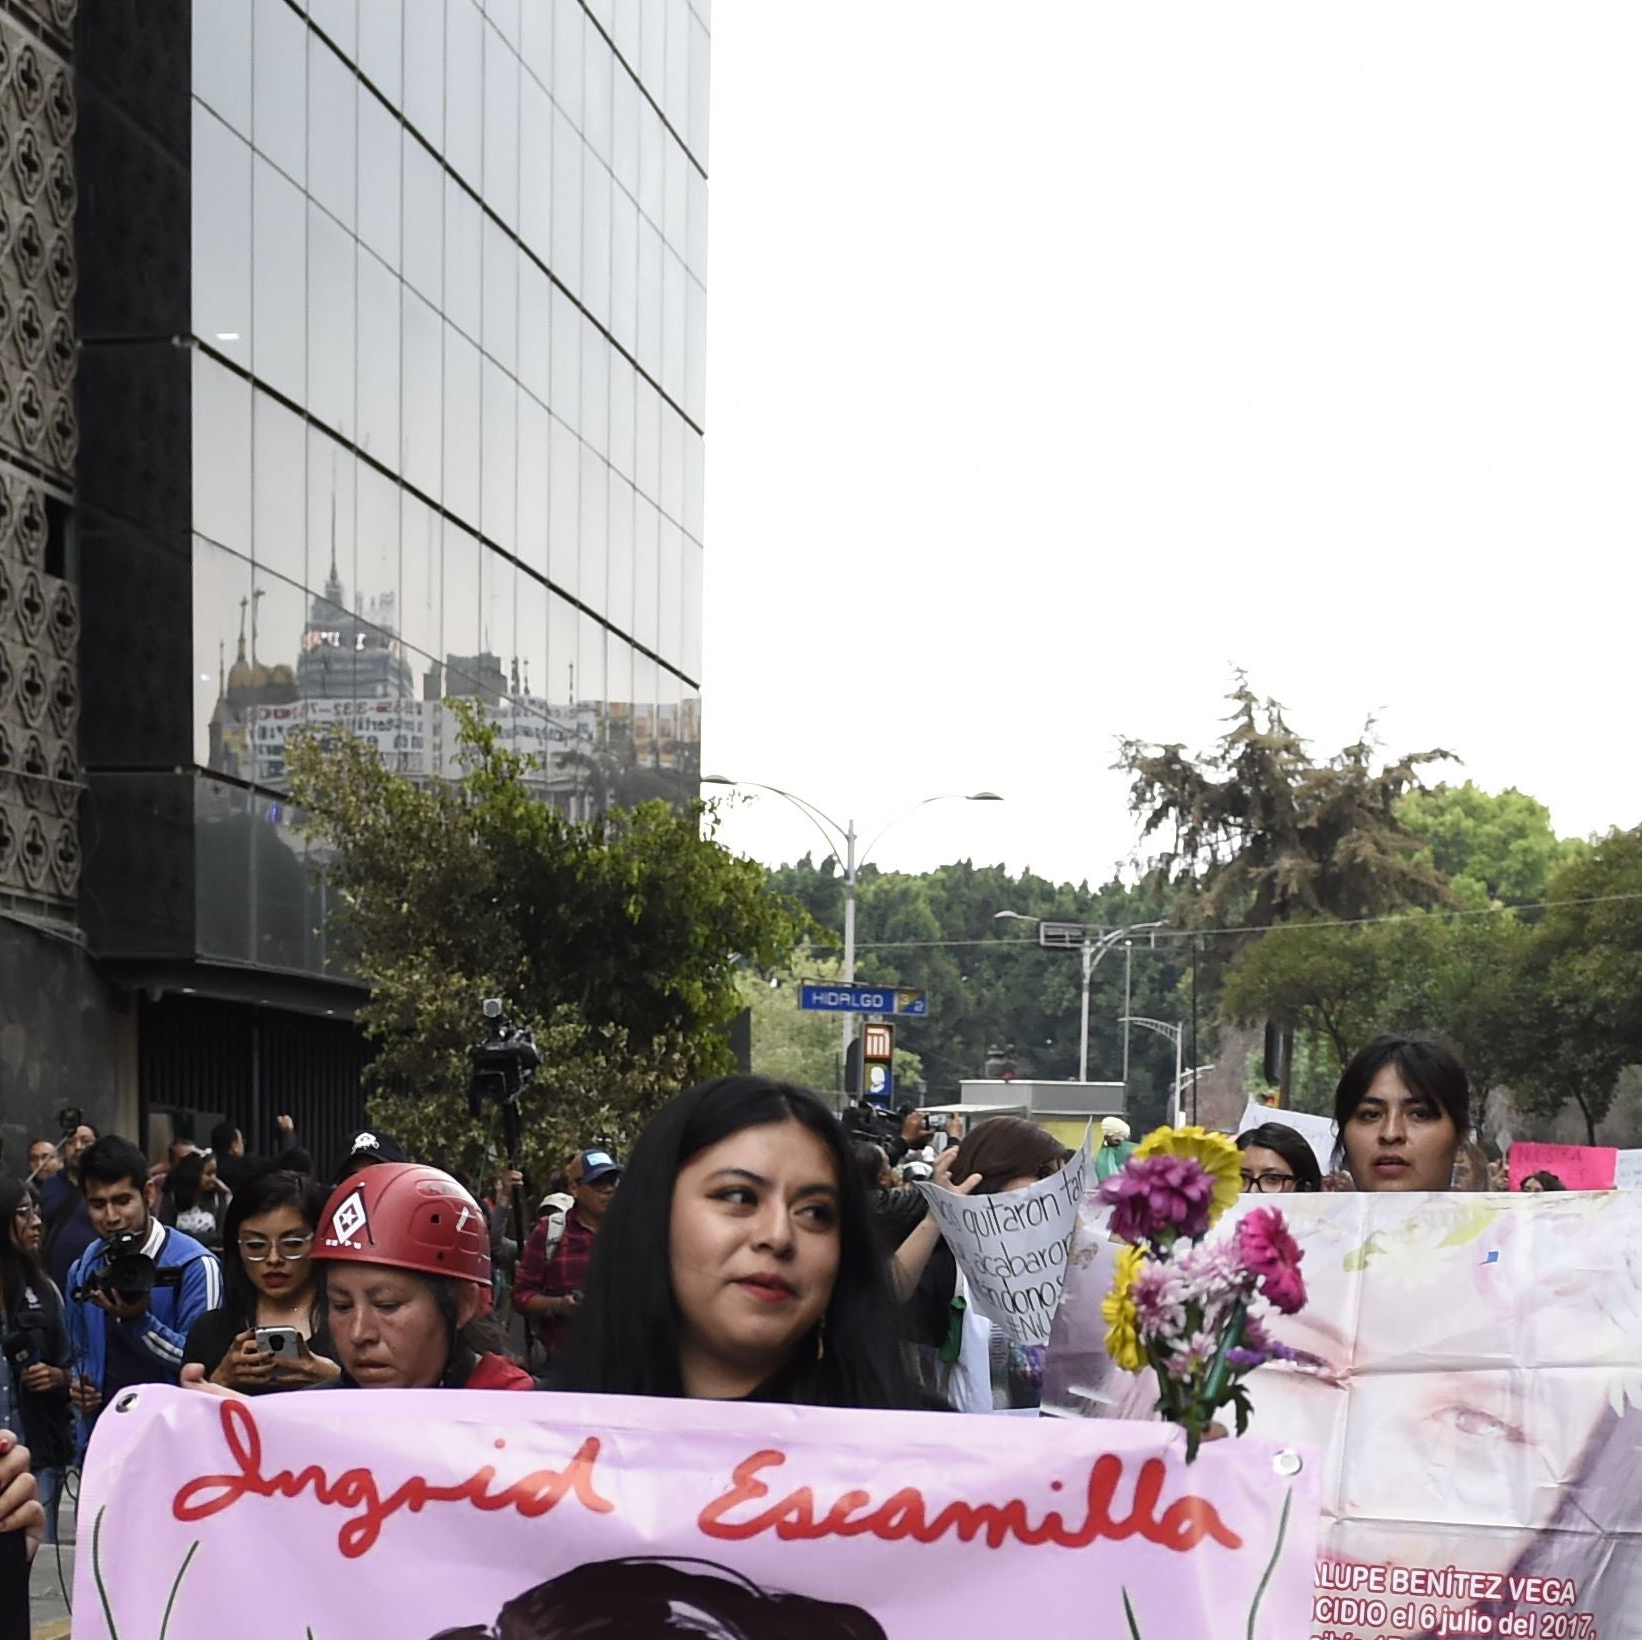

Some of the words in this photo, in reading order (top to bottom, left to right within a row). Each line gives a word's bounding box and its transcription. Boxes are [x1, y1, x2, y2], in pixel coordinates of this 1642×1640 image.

[812, 992, 884, 1008] HIDALGO
[914, 1001, 924, 1012] 2
[962, 1192, 1061, 1246] quitaron
[170, 1399, 615, 1559] Ingrid
[697, 1448, 1243, 1552] Escamilla
[1392, 1566, 1503, 1600] BENÍTEZ
[1509, 1577, 1576, 1605] VEGA
[1392, 1604, 1415, 1629] el
[1420, 1606, 1437, 1630] 6
[1438, 1608, 1493, 1636] julio
[1498, 1612, 1536, 1637] del
